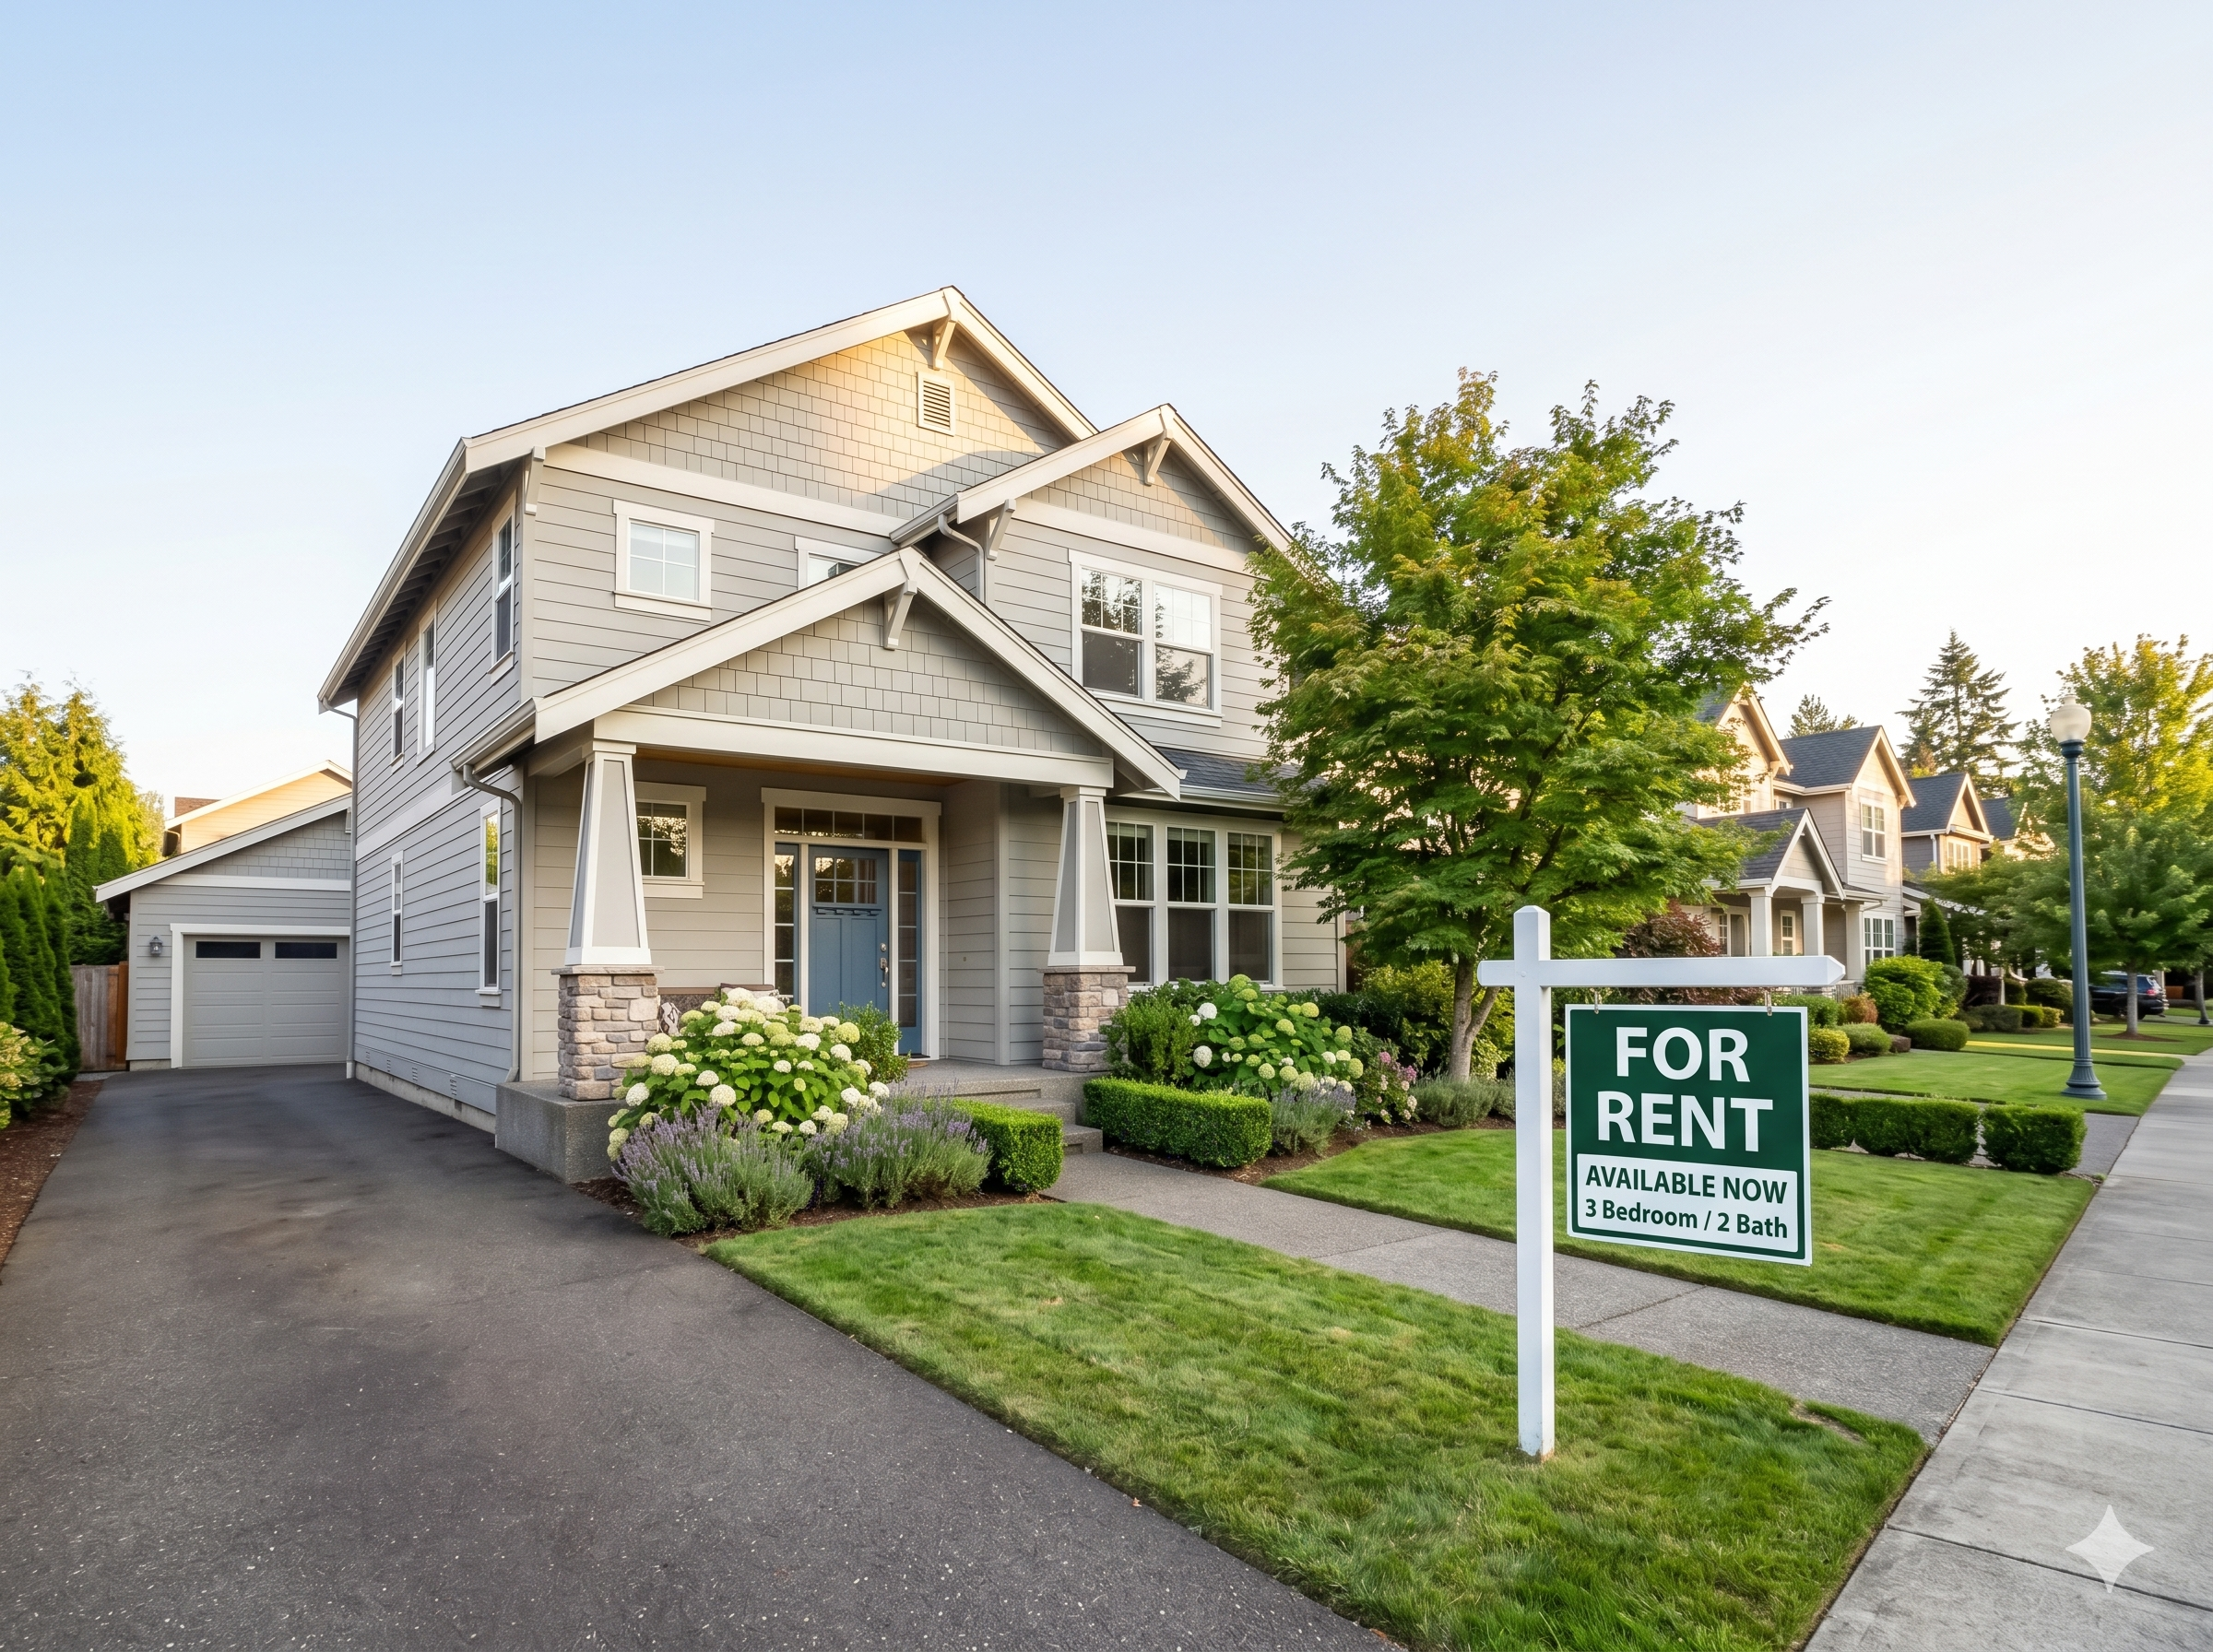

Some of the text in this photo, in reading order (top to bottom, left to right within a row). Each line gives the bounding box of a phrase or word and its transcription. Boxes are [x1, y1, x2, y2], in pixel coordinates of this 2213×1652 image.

[1616, 1027, 1750, 1082] FOR
[1598, 1091, 1773, 1152] RENT
[1585, 1165, 1788, 1204] AVAILABLE NOW
[1585, 1198, 1788, 1239] 3 Bedroom / 2 Bath
